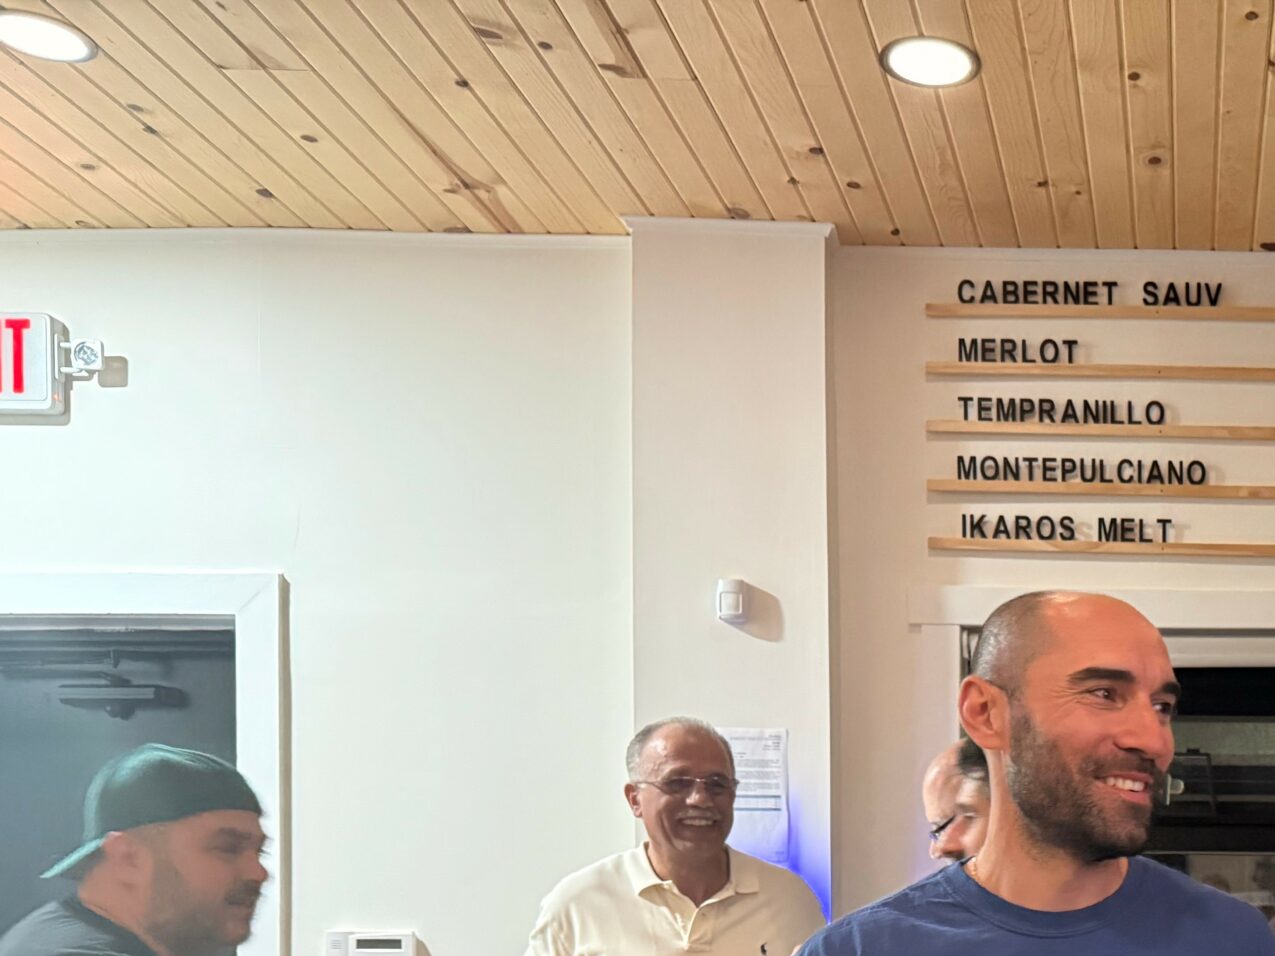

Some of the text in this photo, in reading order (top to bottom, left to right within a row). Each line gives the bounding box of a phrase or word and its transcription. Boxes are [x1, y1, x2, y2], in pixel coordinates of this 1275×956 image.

[957, 280, 1118, 306] CABERNET
[1142, 281, 1223, 307] SAUV
[0, 318, 31, 394] T
[957, 338, 1078, 364] MERLOT
[957, 396, 1165, 425] TEMPRANILLO
[956, 455, 1207, 485] MONTEPULCIANO
[961, 514, 1076, 541] IKAROS
[1098, 518, 1172, 542] MELT
